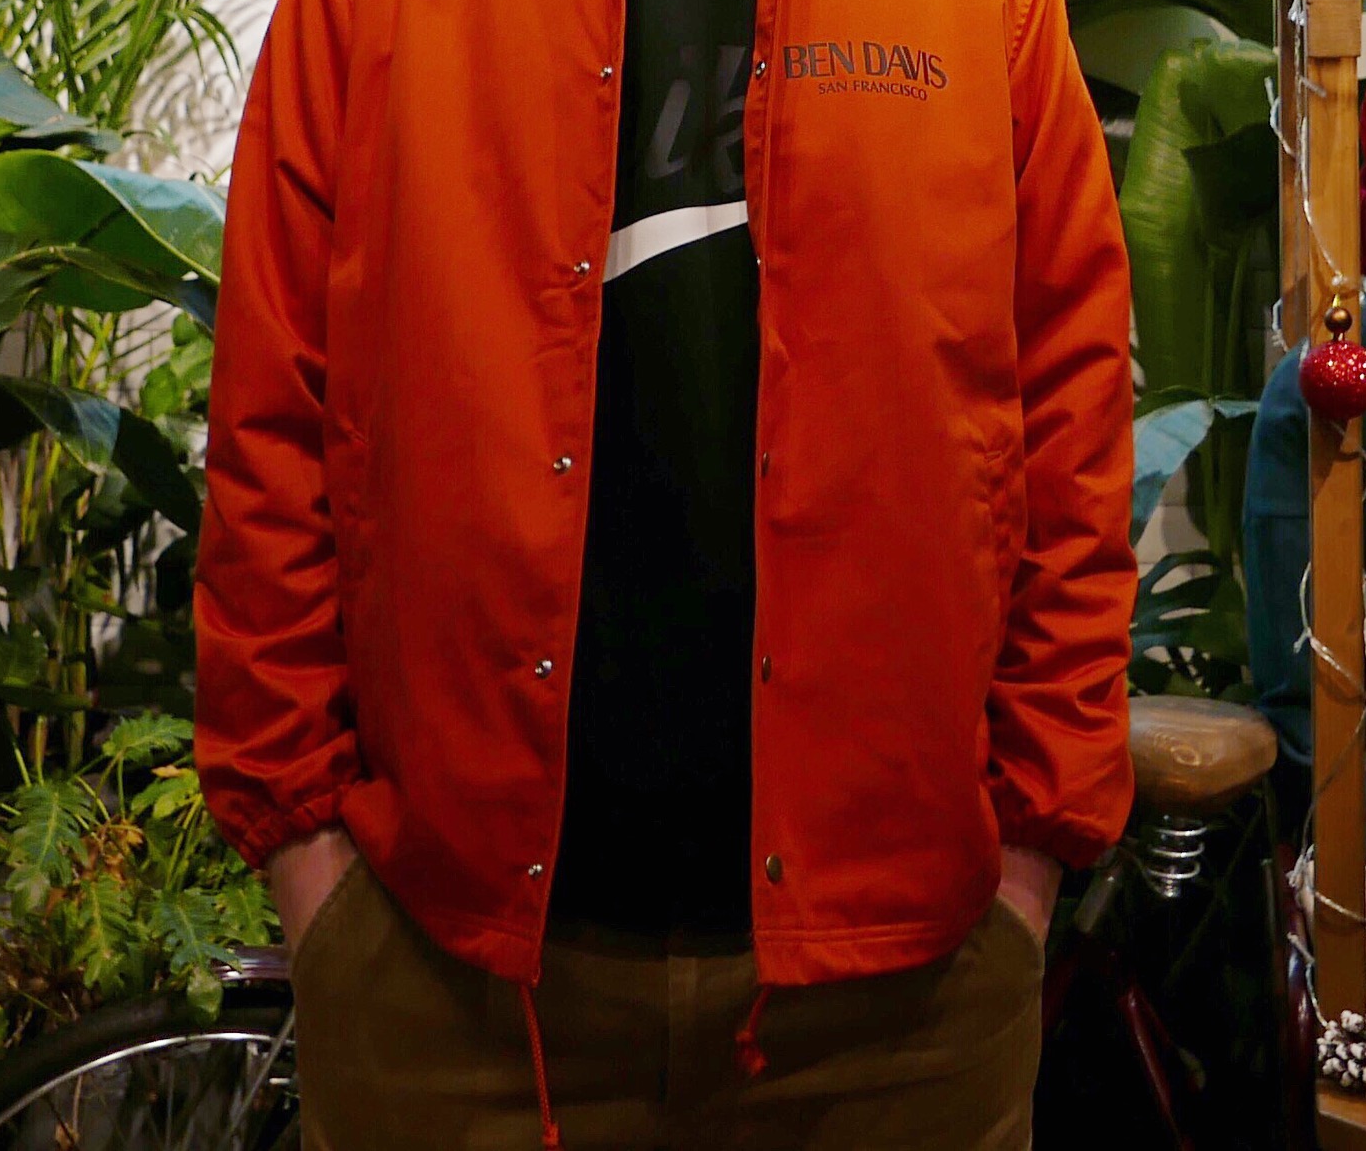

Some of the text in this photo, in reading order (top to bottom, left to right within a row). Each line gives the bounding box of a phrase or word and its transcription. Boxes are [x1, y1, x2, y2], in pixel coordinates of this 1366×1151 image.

[783, 41, 948, 89] BEN DAVIS
[818, 80, 929, 101] SAN FRANCISCO
